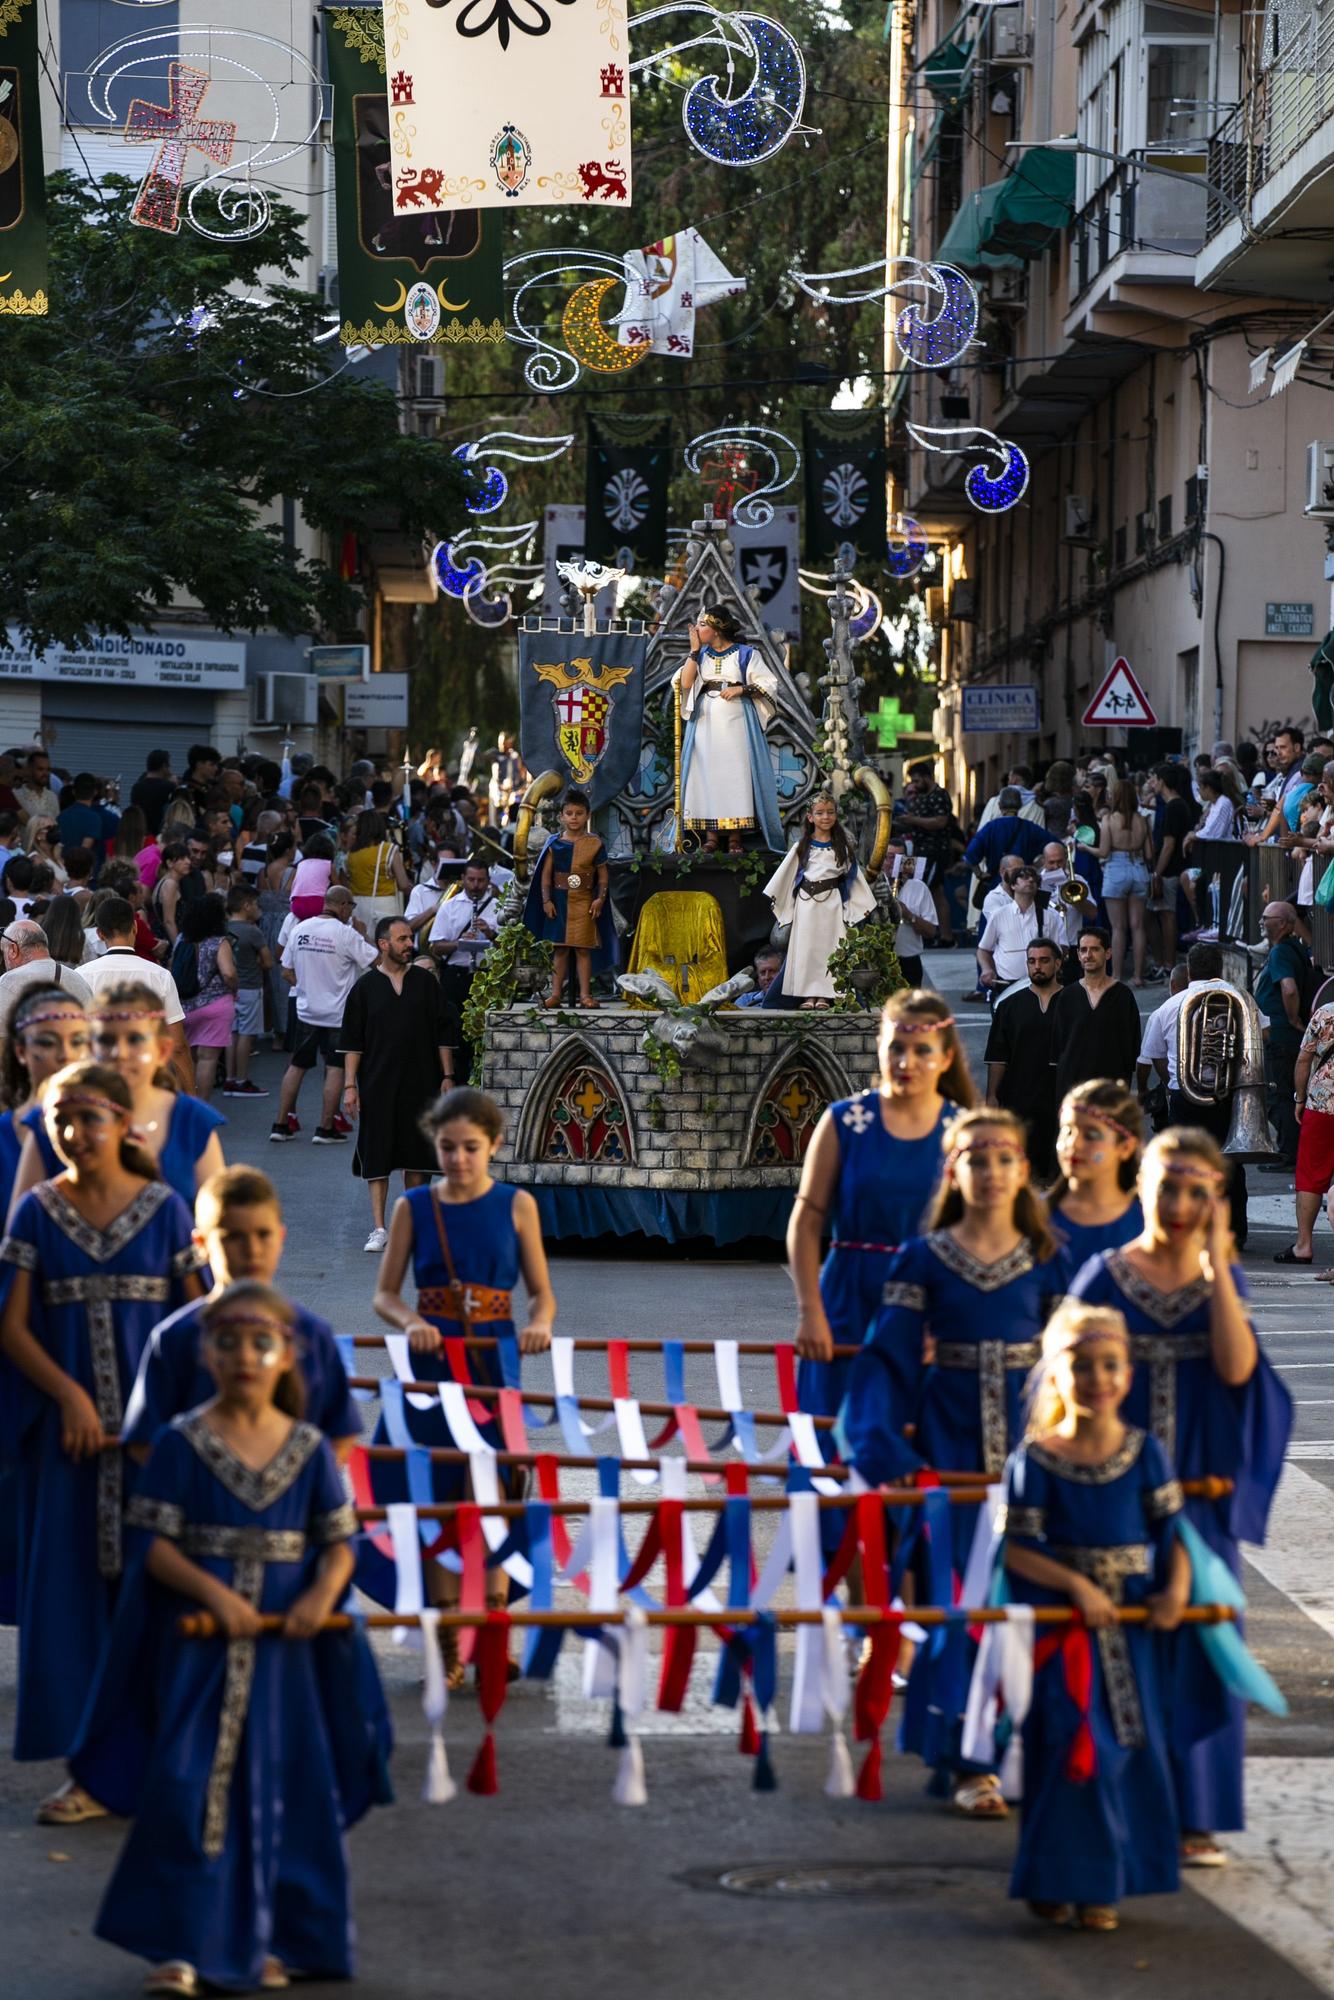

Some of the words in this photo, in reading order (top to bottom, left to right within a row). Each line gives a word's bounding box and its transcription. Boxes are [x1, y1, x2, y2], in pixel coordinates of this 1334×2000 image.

[489, 132, 502, 154] MOROS
[515, 129, 532, 154] CRISTIANOS
[496, 182, 505, 191] SAN
[519, 178, 531, 191] BLAS
[1280, 605, 1307, 613] CALLE
[66, 638, 186, 657] NDICIONADO
[967, 690, 1033, 705] CLÍNICA
[297, 934, 310, 946] 25
